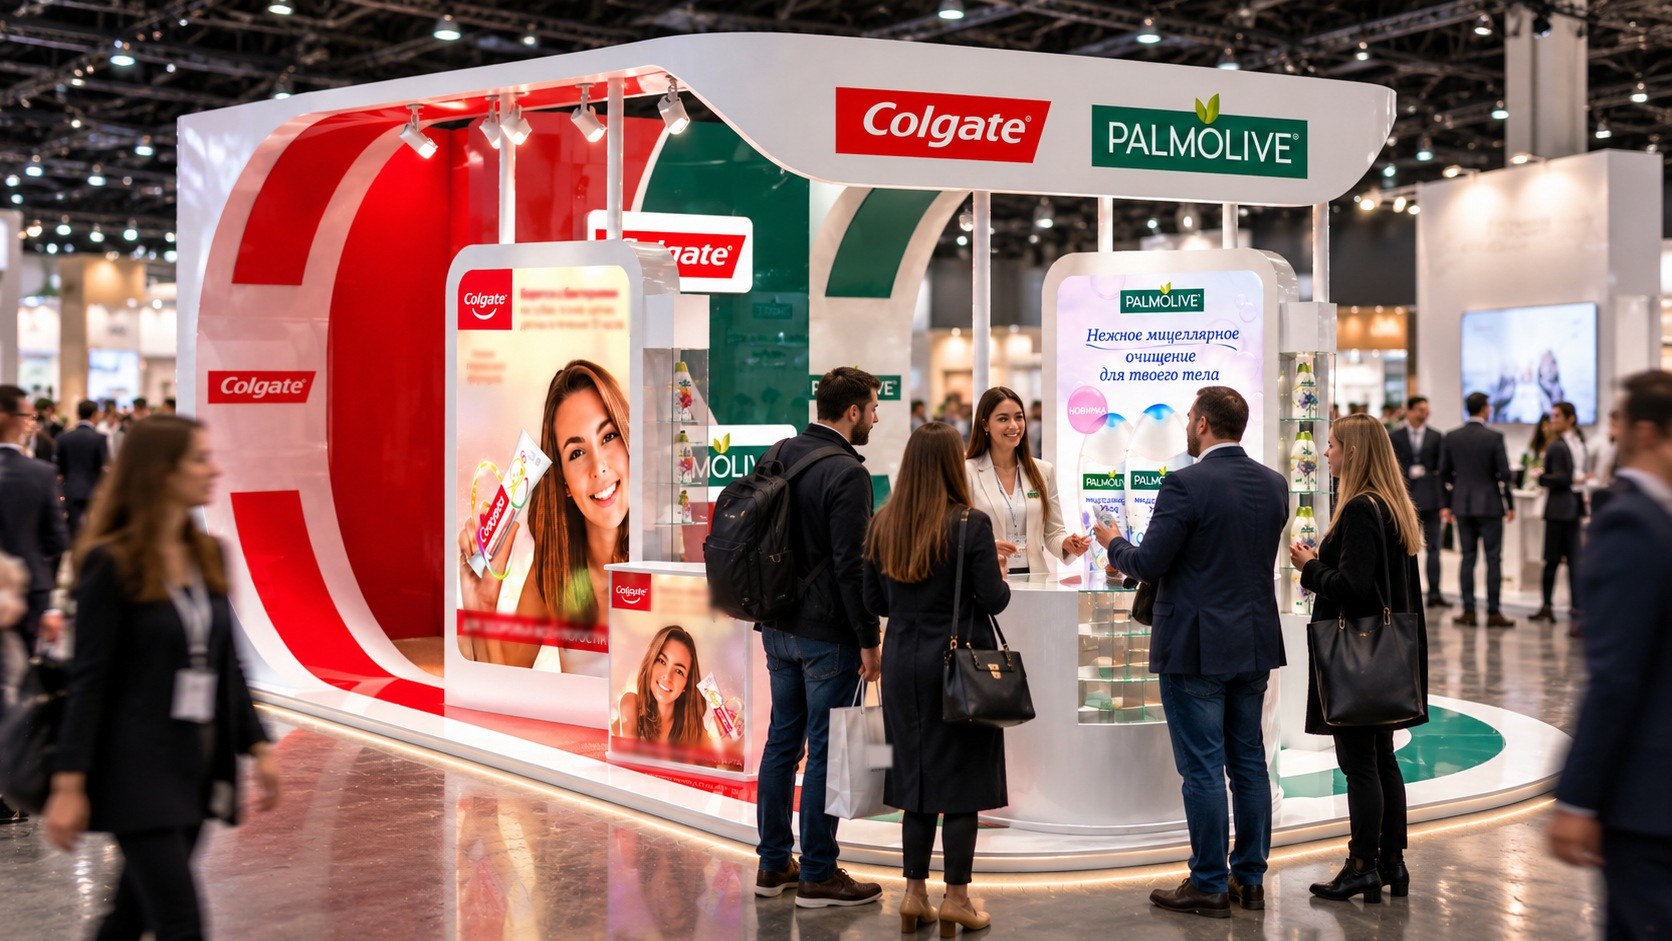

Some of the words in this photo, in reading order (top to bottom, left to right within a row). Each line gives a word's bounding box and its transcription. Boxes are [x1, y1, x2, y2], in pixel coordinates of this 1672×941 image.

[863, 102, 1027, 149] Colgate
[1108, 121, 1293, 164] PALMOLIVE
[464, 292, 506, 308] Colgate
[1126, 294, 1199, 308] PALMOLIVE
[1086, 328, 1143, 342] Нежное
[1146, 329, 1240, 344] мицеллярное
[1125, 352, 1196, 366] очищение
[1100, 367, 1125, 381] для
[1129, 371, 1178, 381] твоего
[1182, 369, 1220, 381] тела
[220, 376, 305, 399] Colgate
